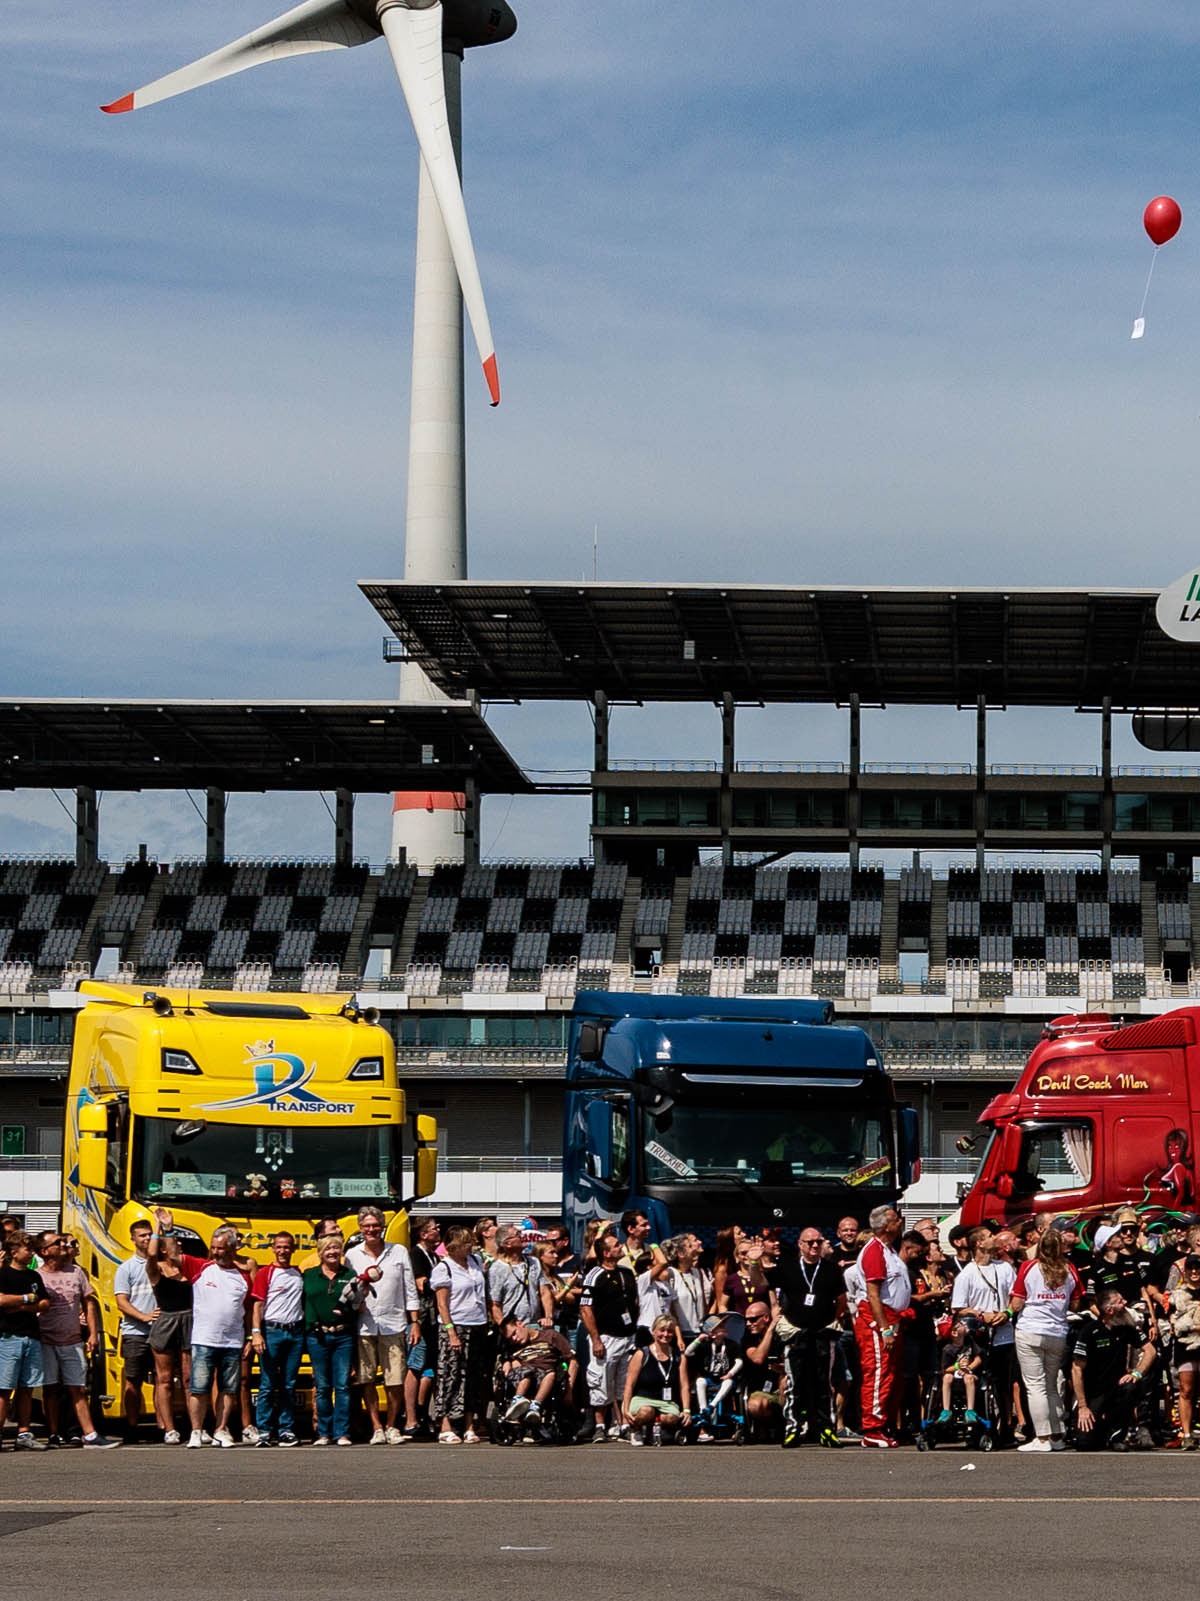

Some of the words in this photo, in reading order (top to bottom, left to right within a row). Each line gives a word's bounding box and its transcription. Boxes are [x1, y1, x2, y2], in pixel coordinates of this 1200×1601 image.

[1036, 1074, 1071, 1090] Devil
[1074, 1074, 1112, 1090] Coach
[269, 1102, 355, 1113] TRANSPORT
[7, 1131, 20, 1141] 31
